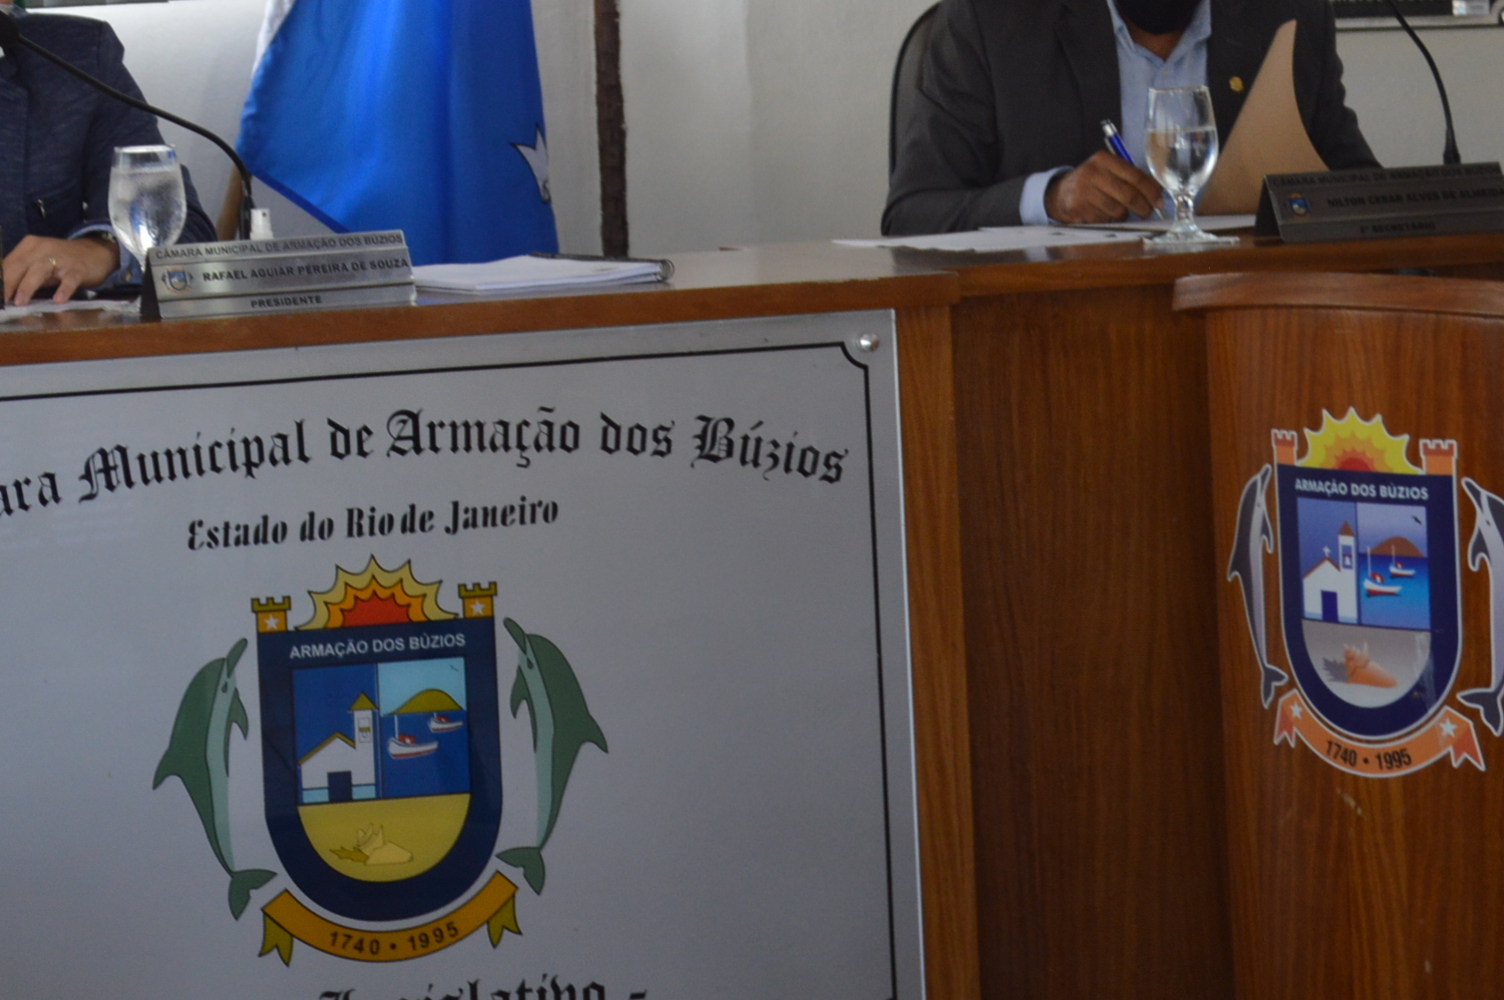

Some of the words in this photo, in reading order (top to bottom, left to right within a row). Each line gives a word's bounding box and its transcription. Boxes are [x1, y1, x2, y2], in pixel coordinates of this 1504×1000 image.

[204, 243, 264, 257] MUNICIPAL
[265, 241, 278, 253] DE
[339, 236, 363, 247] DOS
[202, 269, 248, 282] RAFAEL
[250, 266, 295, 279] AGUIAR
[297, 262, 349, 277] PEREIRA
[351, 260, 367, 272] DE
[369, 258, 410, 270] SOUZA
[250, 295, 323, 308] PRESIDENTE
[78, 419, 313, 503] Municipal
[327, 417, 375, 459] de
[386, 406, 581, 469] Armação
[600, 411, 676, 458] dos
[690, 414, 850, 484] Búzios
[1295, 477, 1348, 498] ARMAÇÃO
[1350, 482, 1377, 497] DOS
[187, 515, 288, 551] Estado
[299, 511, 334, 542] do
[345, 507, 394, 538] Rio
[400, 503, 434, 534] de
[444, 496, 559, 536] Janeiro
[289, 638, 368, 659] ARMAÇÃO
[372, 637, 405, 653] DOS
[1326, 740, 1358, 767] 1740
[1375, 747, 1413, 771] 1995
[329, 930, 380, 955] 1740
[408, 920, 459, 951] 1995
